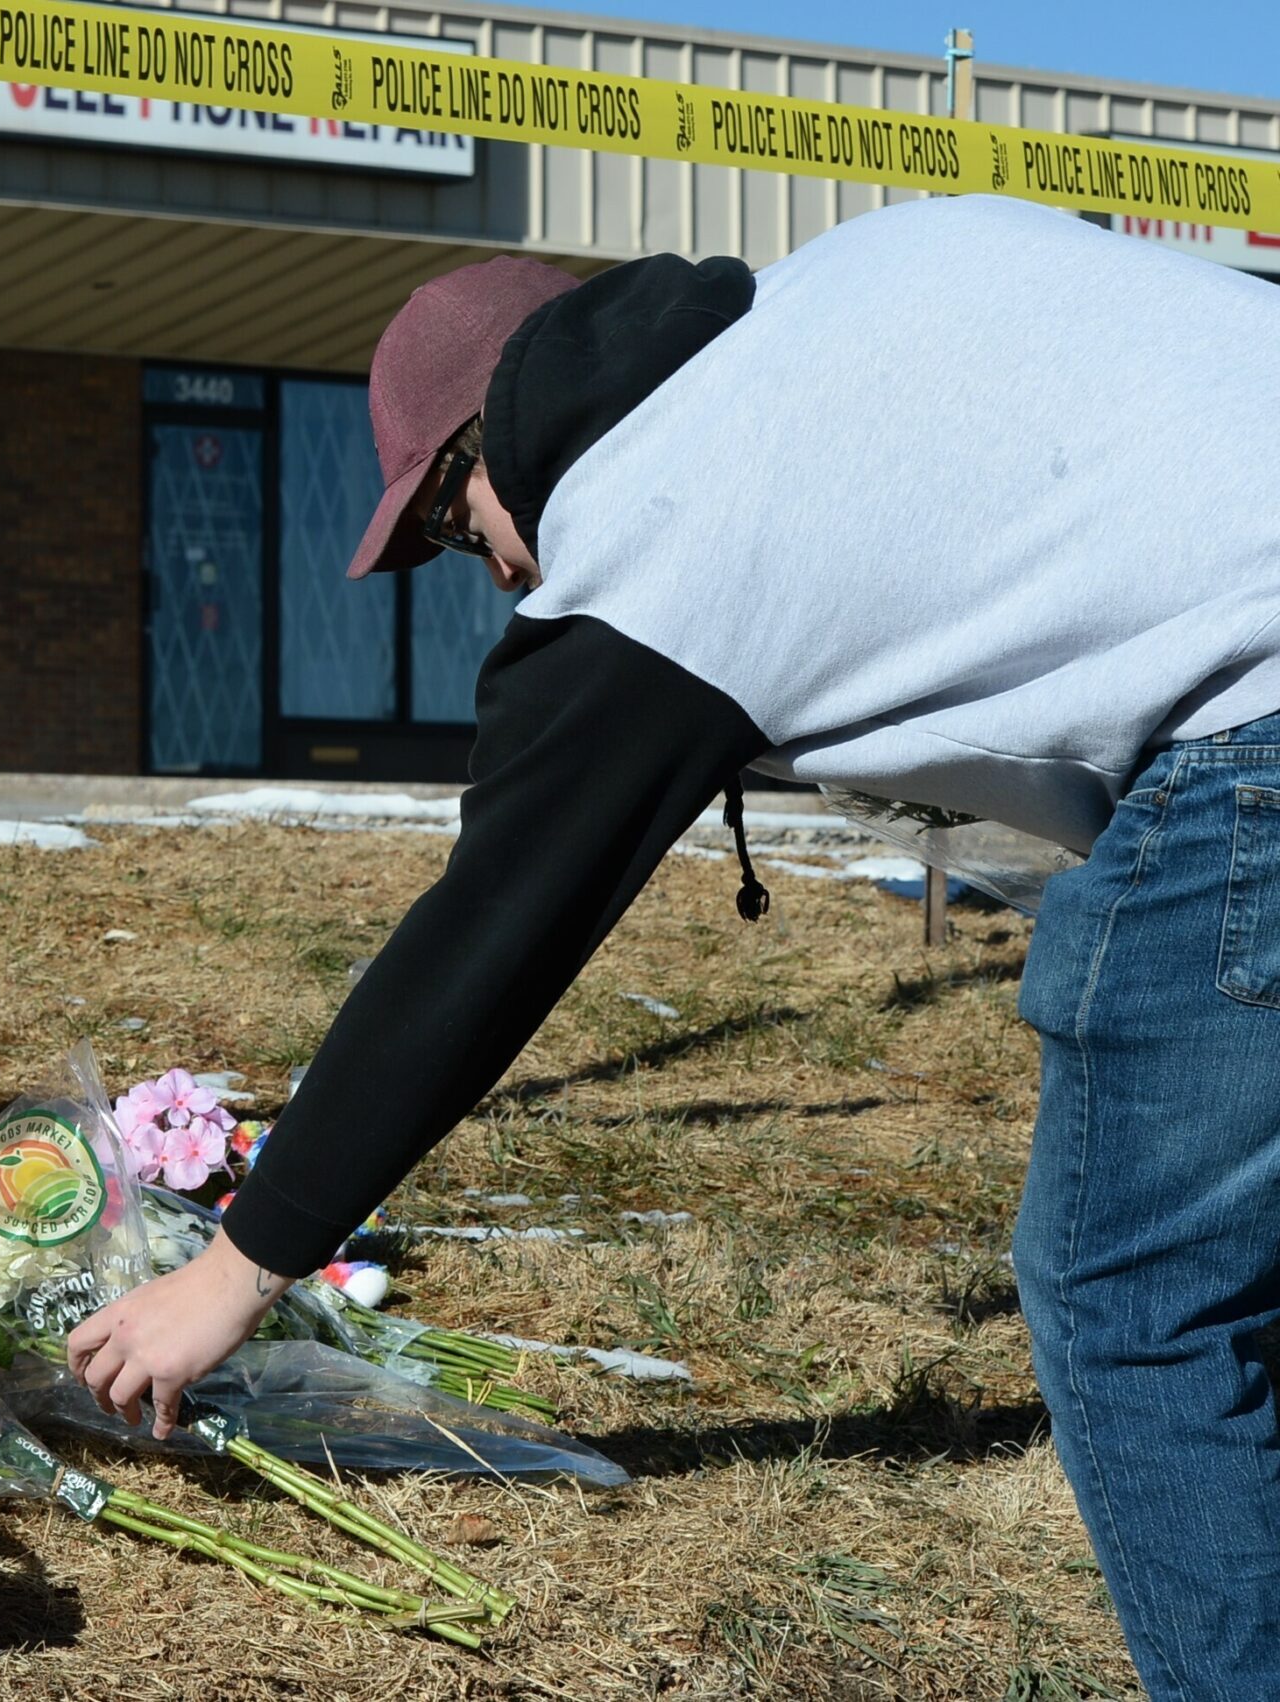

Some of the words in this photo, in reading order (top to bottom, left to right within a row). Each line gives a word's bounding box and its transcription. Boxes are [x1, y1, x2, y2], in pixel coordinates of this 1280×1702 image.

[0, 9, 75, 72] POLICE
[83, 19, 130, 79] LINE
[138, 26, 167, 84] DO
[174, 30, 216, 89] NOT
[223, 36, 293, 98] CROSS
[371, 56, 442, 116] POLICE
[448, 65, 492, 122] LINE
[497, 71, 525, 127] DO
[530, 76, 569, 132] NOT
[576, 81, 641, 140] CROSS
[711, 100, 778, 157] POLICE
[781, 108, 823, 163] LINE
[827, 114, 853, 167] DO
[857, 118, 893, 171] NOT
[899, 123, 960, 180] CROSS
[1022, 141, 1085, 195] POLICE
[1086, 148, 1126, 200] LINE
[1128, 154, 1154, 204] DO
[1156, 157, 1191, 208] NOT
[1194, 162, 1251, 216] CROSS
[174, 375, 234, 405] 3440
[26, 1121, 72, 1150] MARKET
[64, 1205, 88, 1229] FOR
